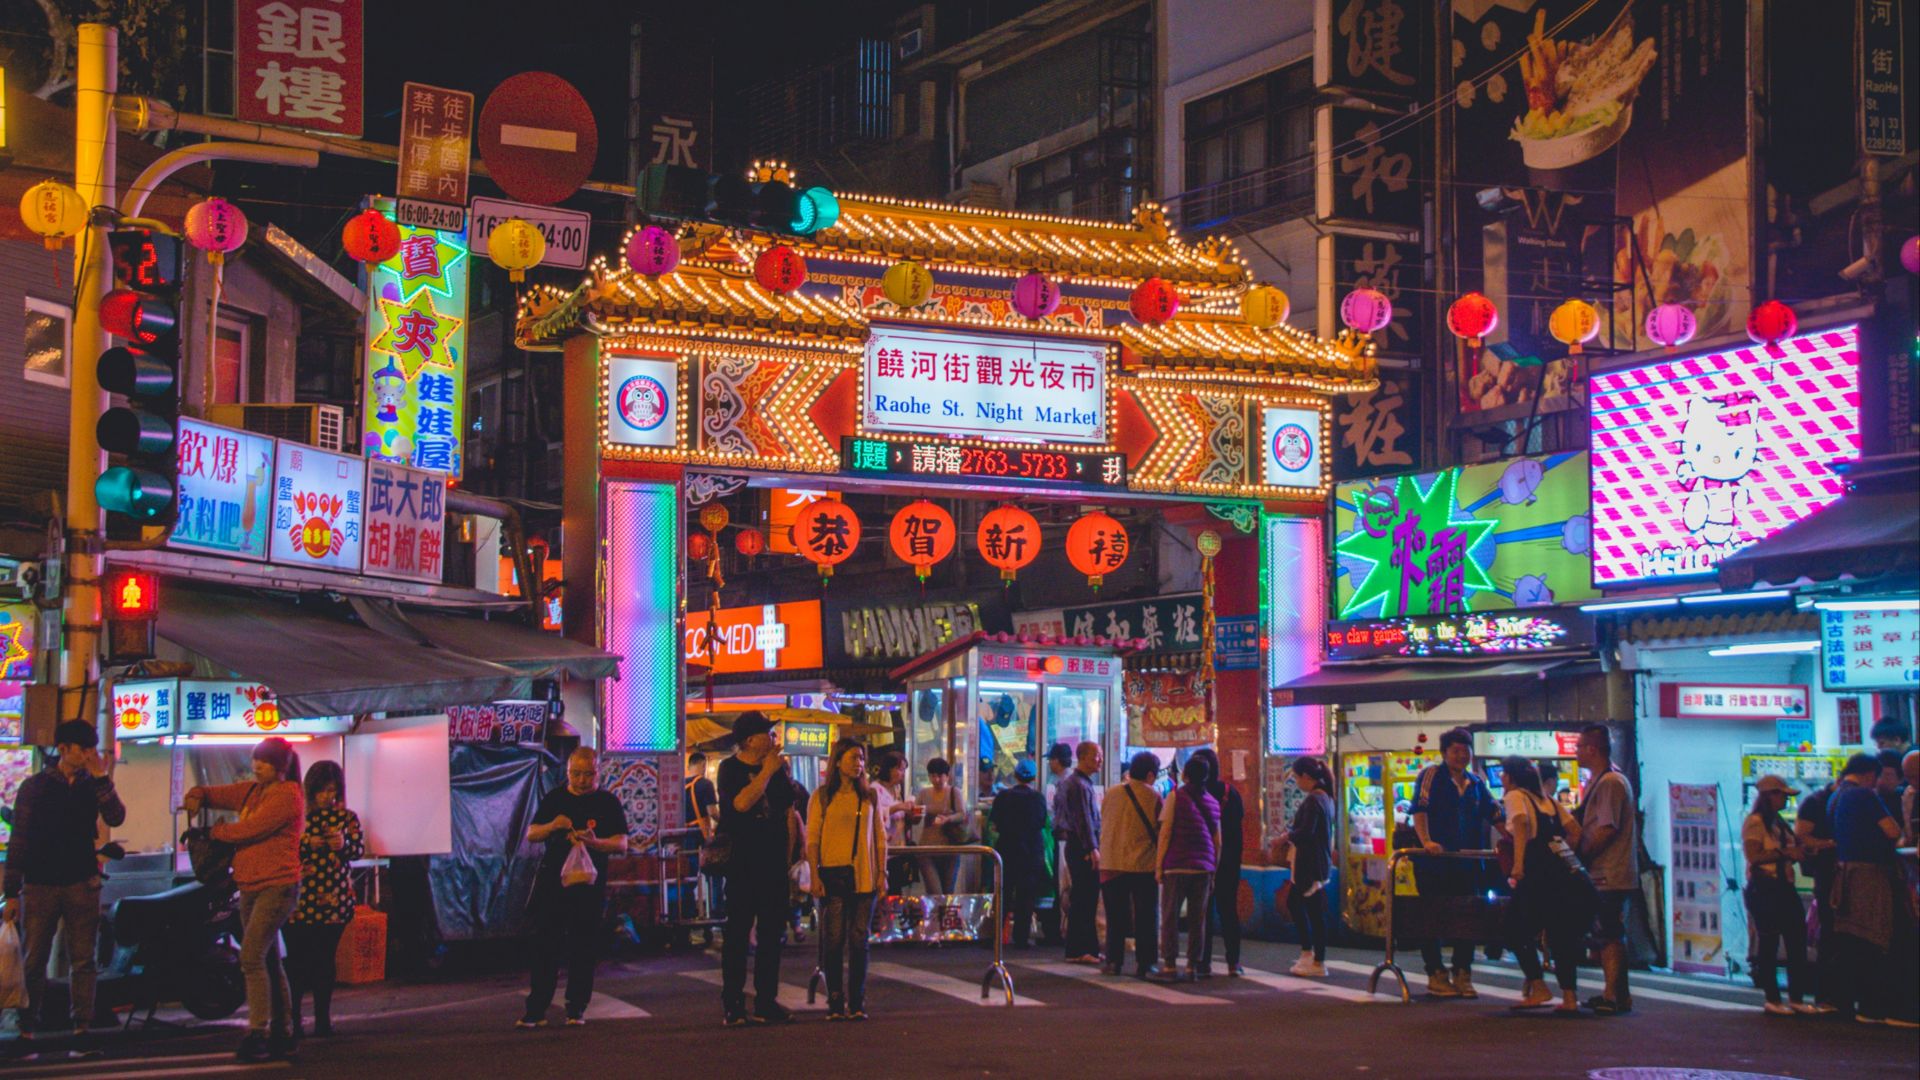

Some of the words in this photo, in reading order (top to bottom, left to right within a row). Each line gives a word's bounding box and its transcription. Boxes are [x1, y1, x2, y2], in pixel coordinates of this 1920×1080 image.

[256, 0, 346, 124] 銀樓
[408, 91, 435, 192] 禁止停車
[438, 96, 464, 197] 徒步區內
[652, 116, 698, 169] 永
[400, 205, 461, 228] 16:00-24:00
[877, 348, 1096, 392] 饒河街觀光夜市
[416, 373, 454, 470] 娃娃屋
[875, 395, 931, 414] Raohe
[942, 400, 964, 417] St.
[976, 402, 1023, 423] Night
[1035, 406, 1097, 425] Market
[175, 485, 241, 545] 飲料吧
[370, 469, 442, 523] 武大郎
[367, 519, 441, 576] 胡椒餅
[1346, 628, 1369, 645] claw
[1373, 628, 1403, 647] games
[1437, 622, 1457, 640] the
[1067, 656, 1111, 676] 服務台
